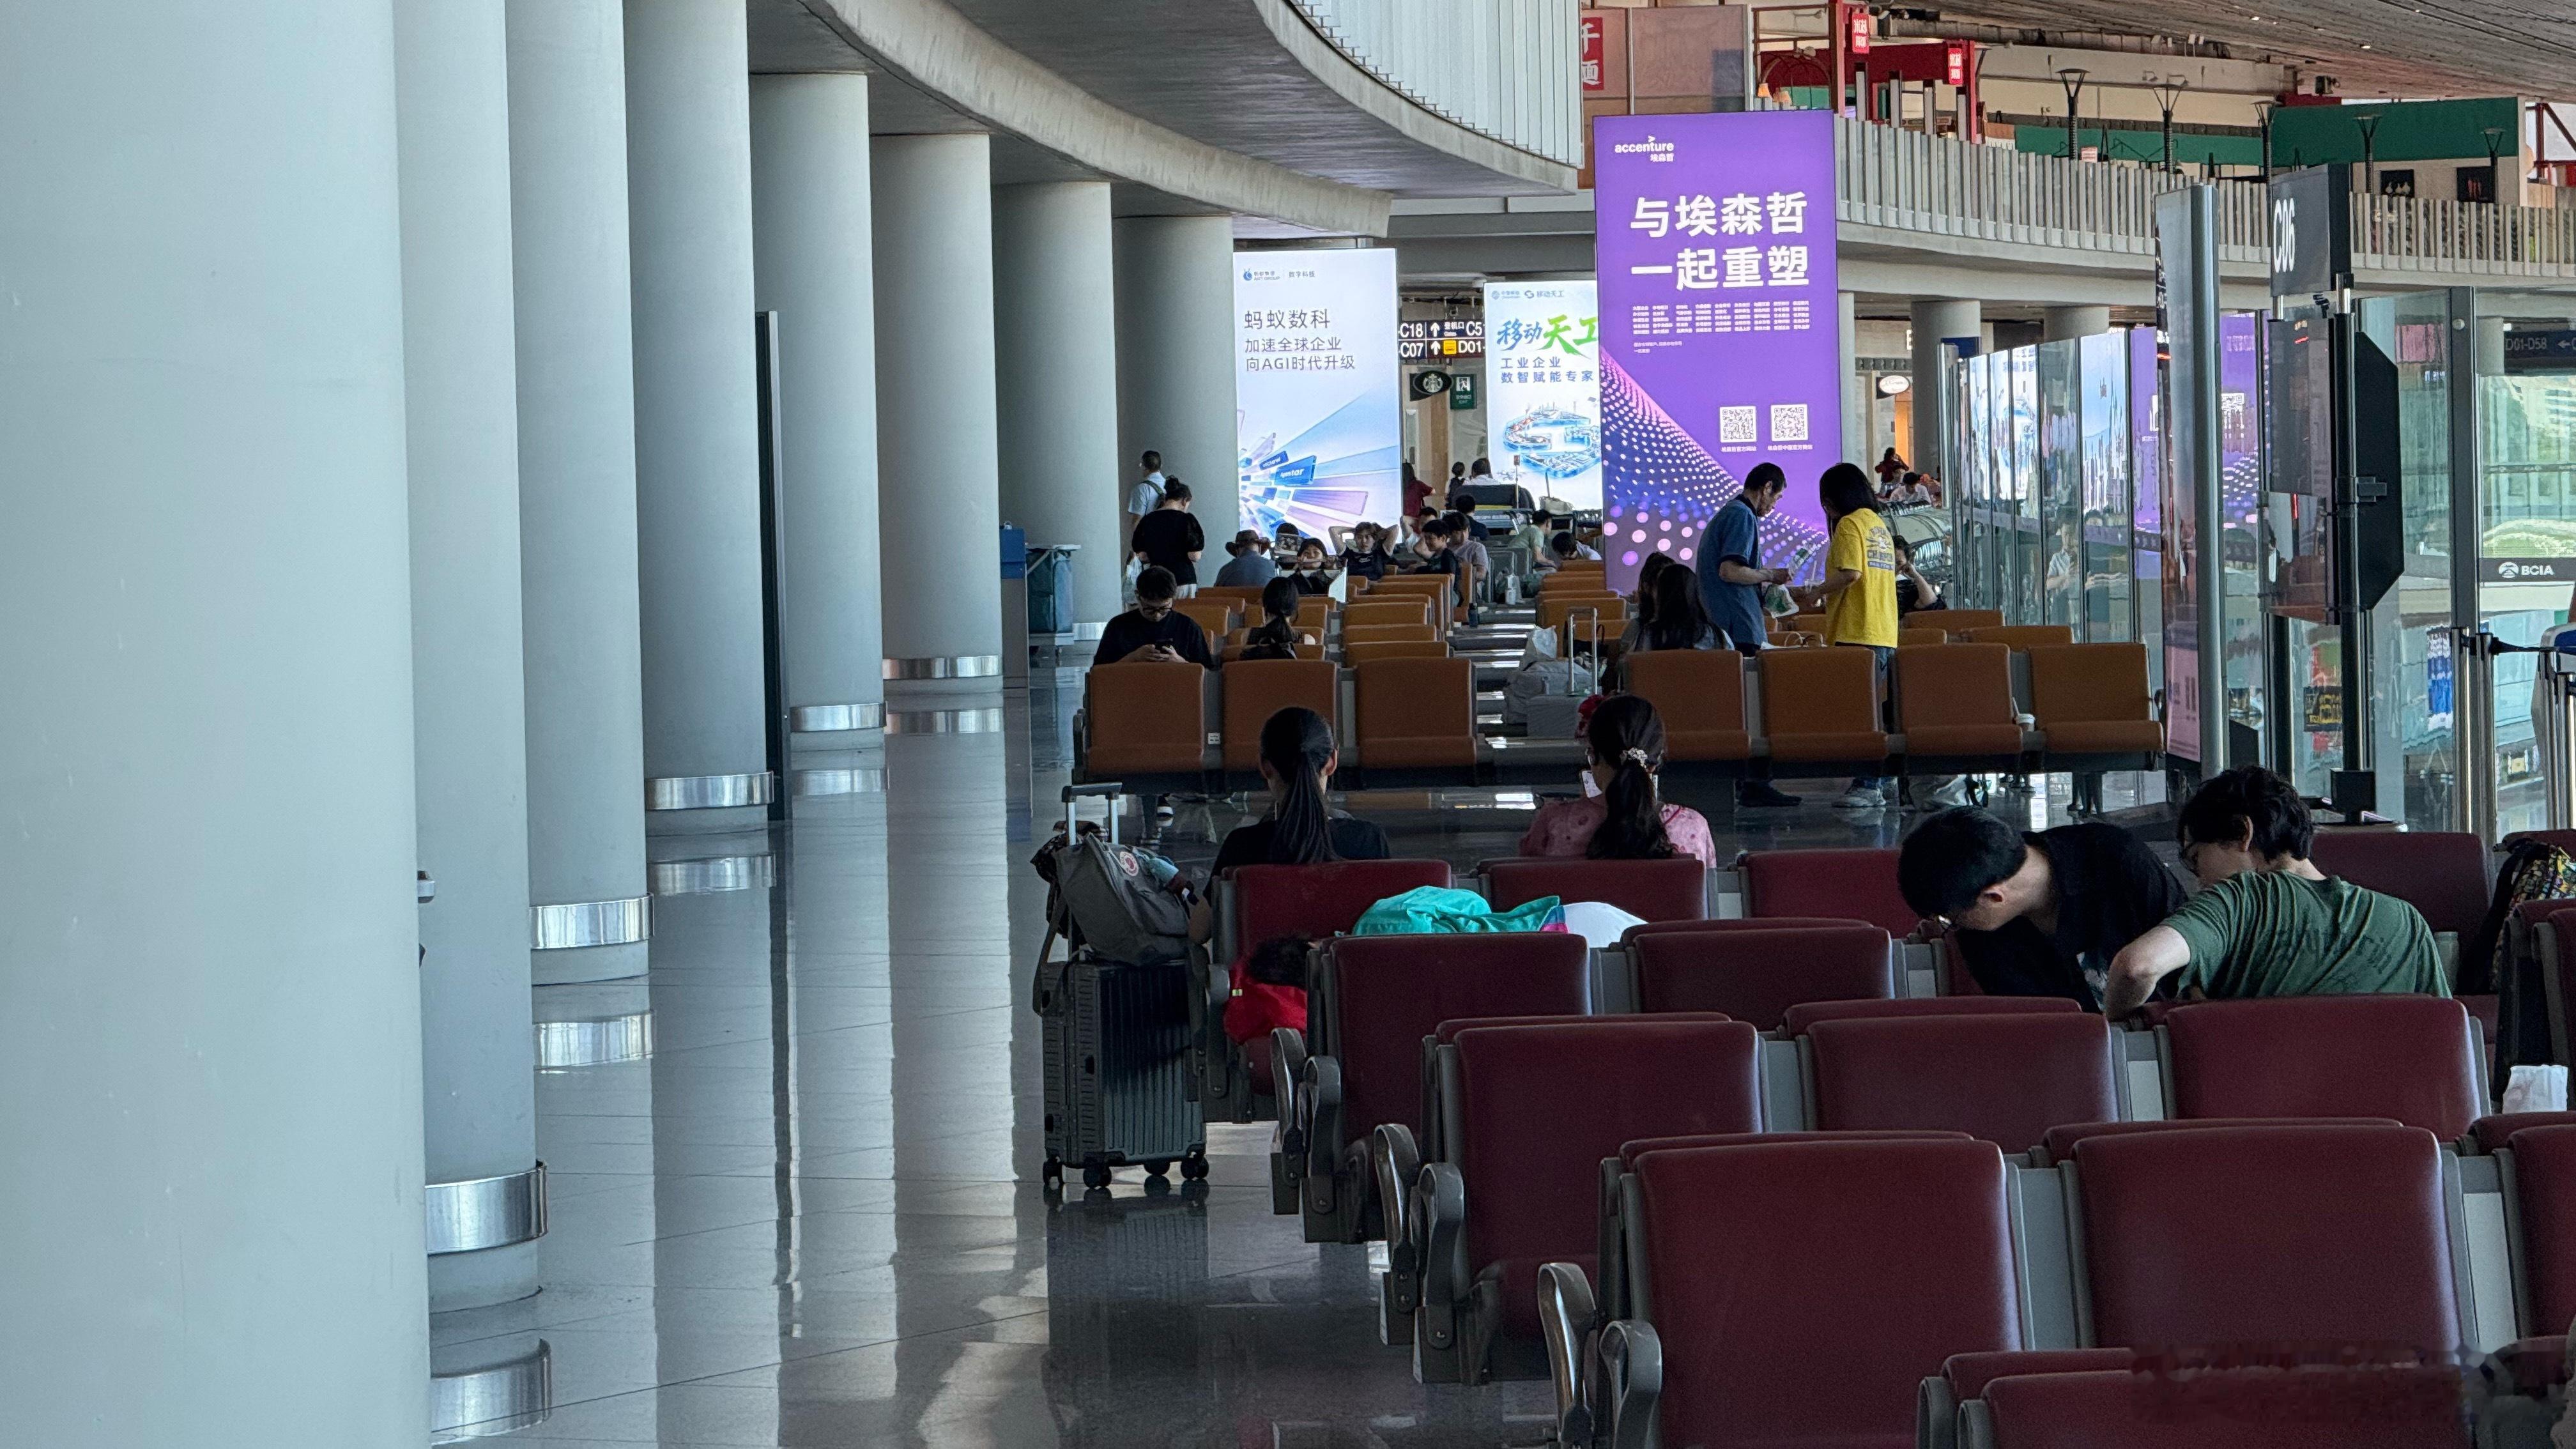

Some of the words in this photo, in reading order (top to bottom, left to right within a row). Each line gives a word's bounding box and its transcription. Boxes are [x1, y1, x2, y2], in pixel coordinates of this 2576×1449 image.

[1614, 136, 1675, 153] accenture
[1650, 153, 1674, 162] 埃森哲
[1630, 191, 1807, 238] 与埃森哲
[2273, 198, 2295, 273] C06
[1631, 245, 1809, 291] 一起重塑
[1244, 309, 1330, 329] 蚂蚁数科
[1400, 323, 1423, 338] C18
[1496, 314, 1598, 360] 移动天工
[1245, 337, 1342, 353] 加速全球企业
[1400, 342, 1424, 358] C07
[1458, 340, 1482, 353] D01
[1246, 355, 1355, 371] 向AGI时代升级
[1501, 356, 1561, 369] 工业企业
[1501, 371, 1595, 384] 数智赋能专家
[2521, 565, 2554, 575] BCIA
